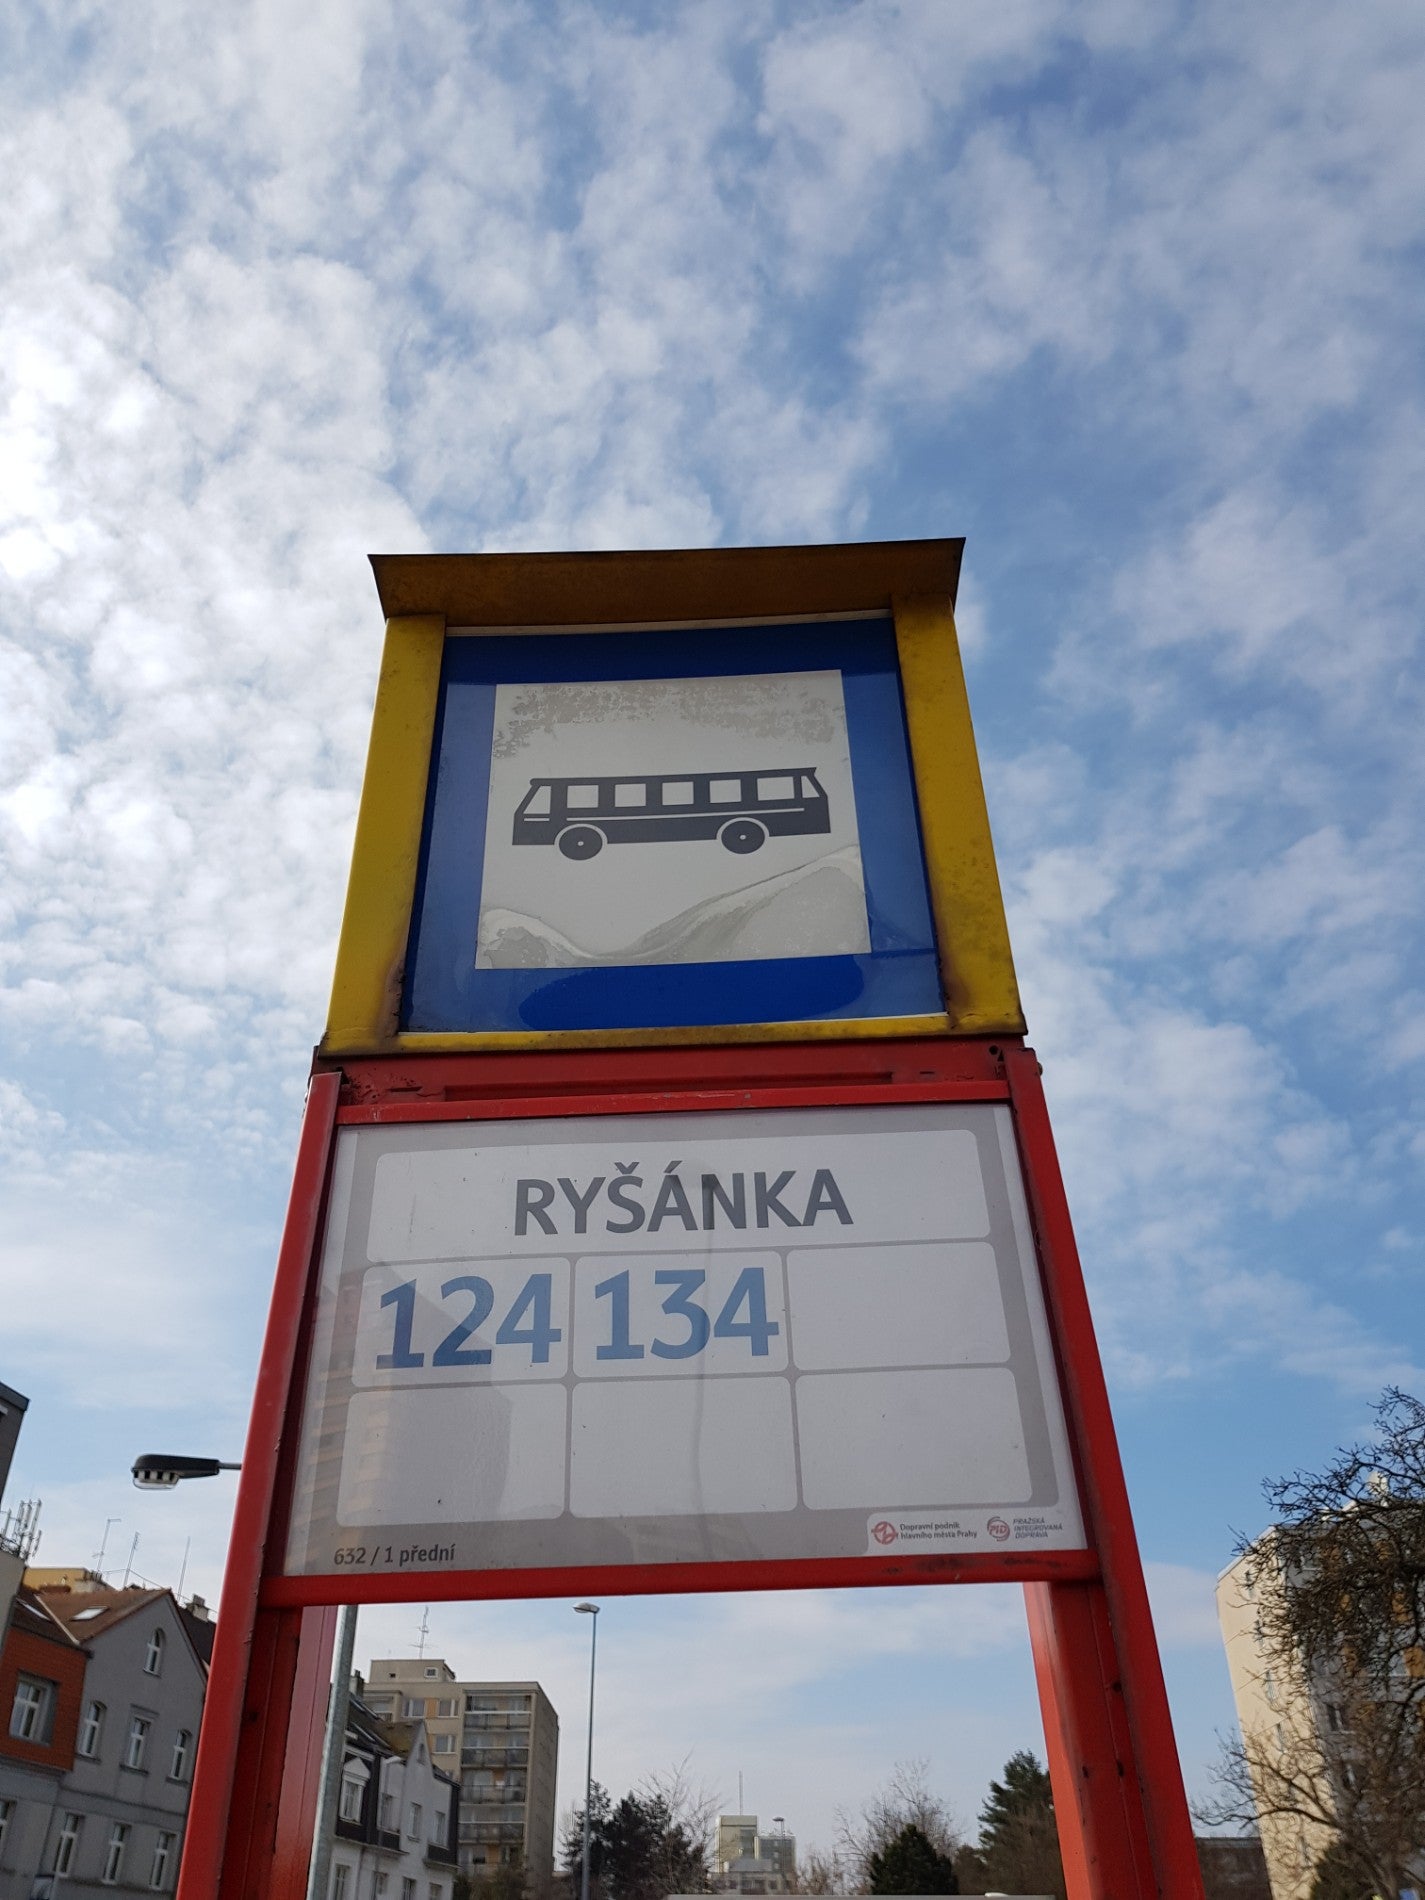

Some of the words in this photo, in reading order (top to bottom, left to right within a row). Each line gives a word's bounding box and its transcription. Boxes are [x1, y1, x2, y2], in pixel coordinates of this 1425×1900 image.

[514, 1160, 853, 1236] RYŠÁNKA
[375, 1272, 562, 1370] 124
[593, 1267, 779, 1361] 134
[899, 1522, 933, 1532] Dopravní
[935, 1521, 960, 1531] podnik
[901, 1531, 932, 1540] hlavního
[933, 1530, 956, 1539] města
[957, 1530, 978, 1540] Prahy
[334, 1547, 366, 1565] 632
[370, 1546, 380, 1566] /
[384, 1546, 394, 1563] 1
[399, 1543, 456, 1567] přední
